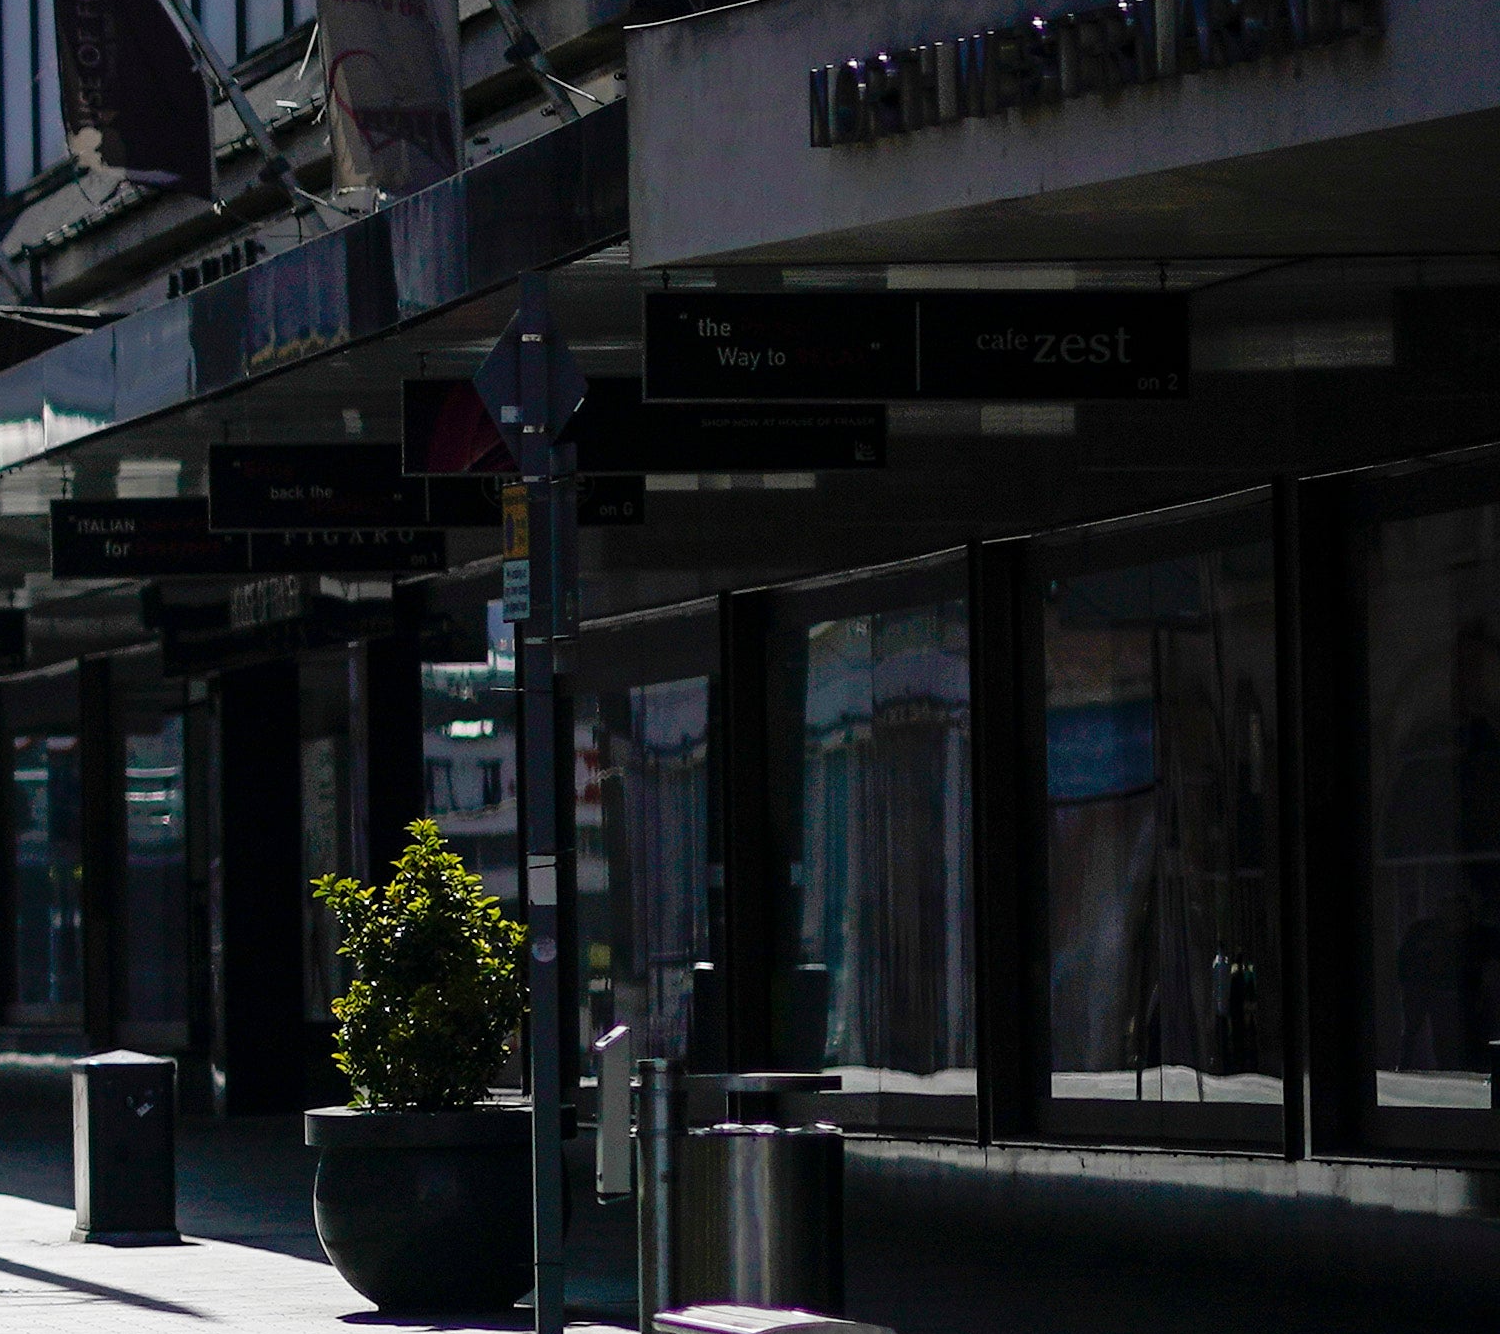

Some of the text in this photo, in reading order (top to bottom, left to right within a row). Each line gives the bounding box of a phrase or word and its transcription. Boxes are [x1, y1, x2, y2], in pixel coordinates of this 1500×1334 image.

[976, 325, 1133, 365] cafe zest
[717, 347, 762, 371] Way
[767, 348, 787, 367] to
[1136, 373, 1179, 392] on 2
[701, 416, 876, 428] SHOP NOW AT HOUSE OF FRASER
[269, 484, 334, 500] back the
[598, 506, 618, 517] on
[104, 539, 132, 557] for
[410, 552, 427, 565] on
